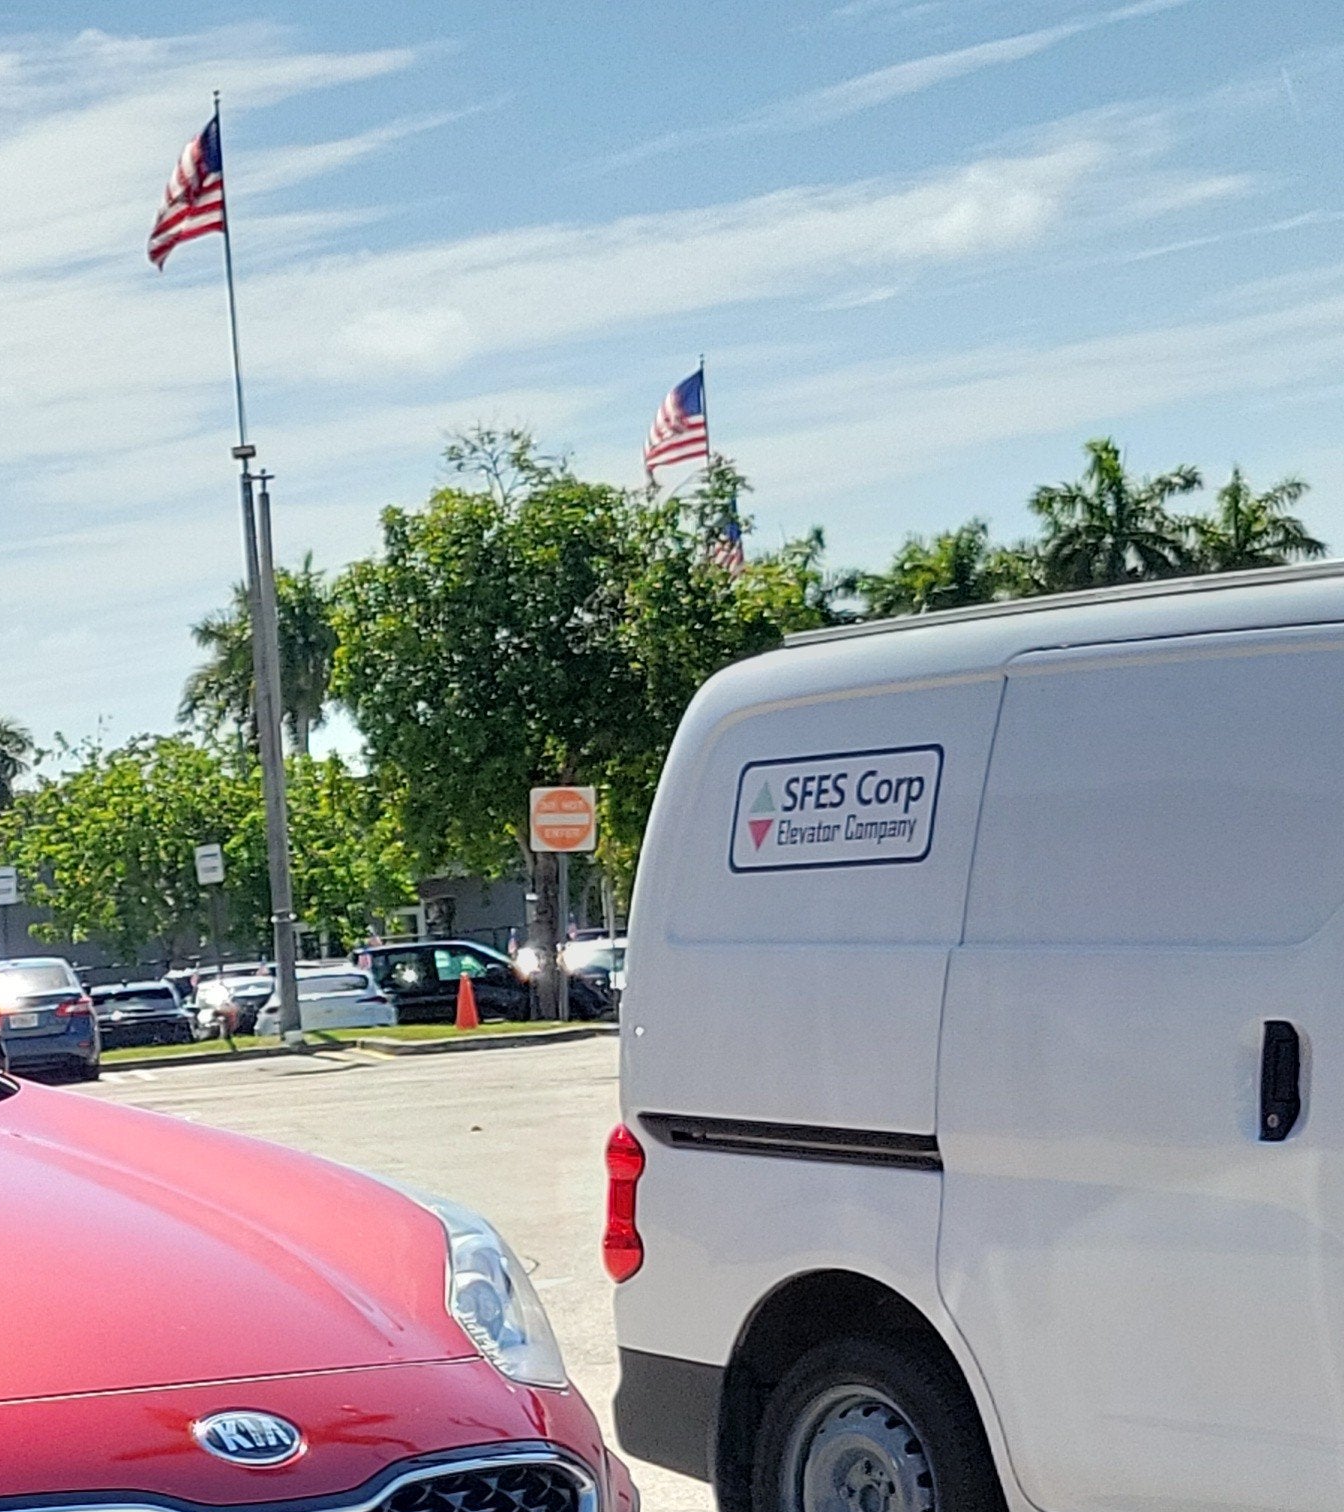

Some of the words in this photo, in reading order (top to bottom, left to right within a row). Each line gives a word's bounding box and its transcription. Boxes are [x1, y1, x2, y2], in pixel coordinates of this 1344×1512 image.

[781, 773, 848, 812] SFES
[856, 770, 925, 814] Corp
[777, 819, 841, 846] Elevator
[845, 814, 917, 845] Company
[212, 1418, 292, 1452] KIA
